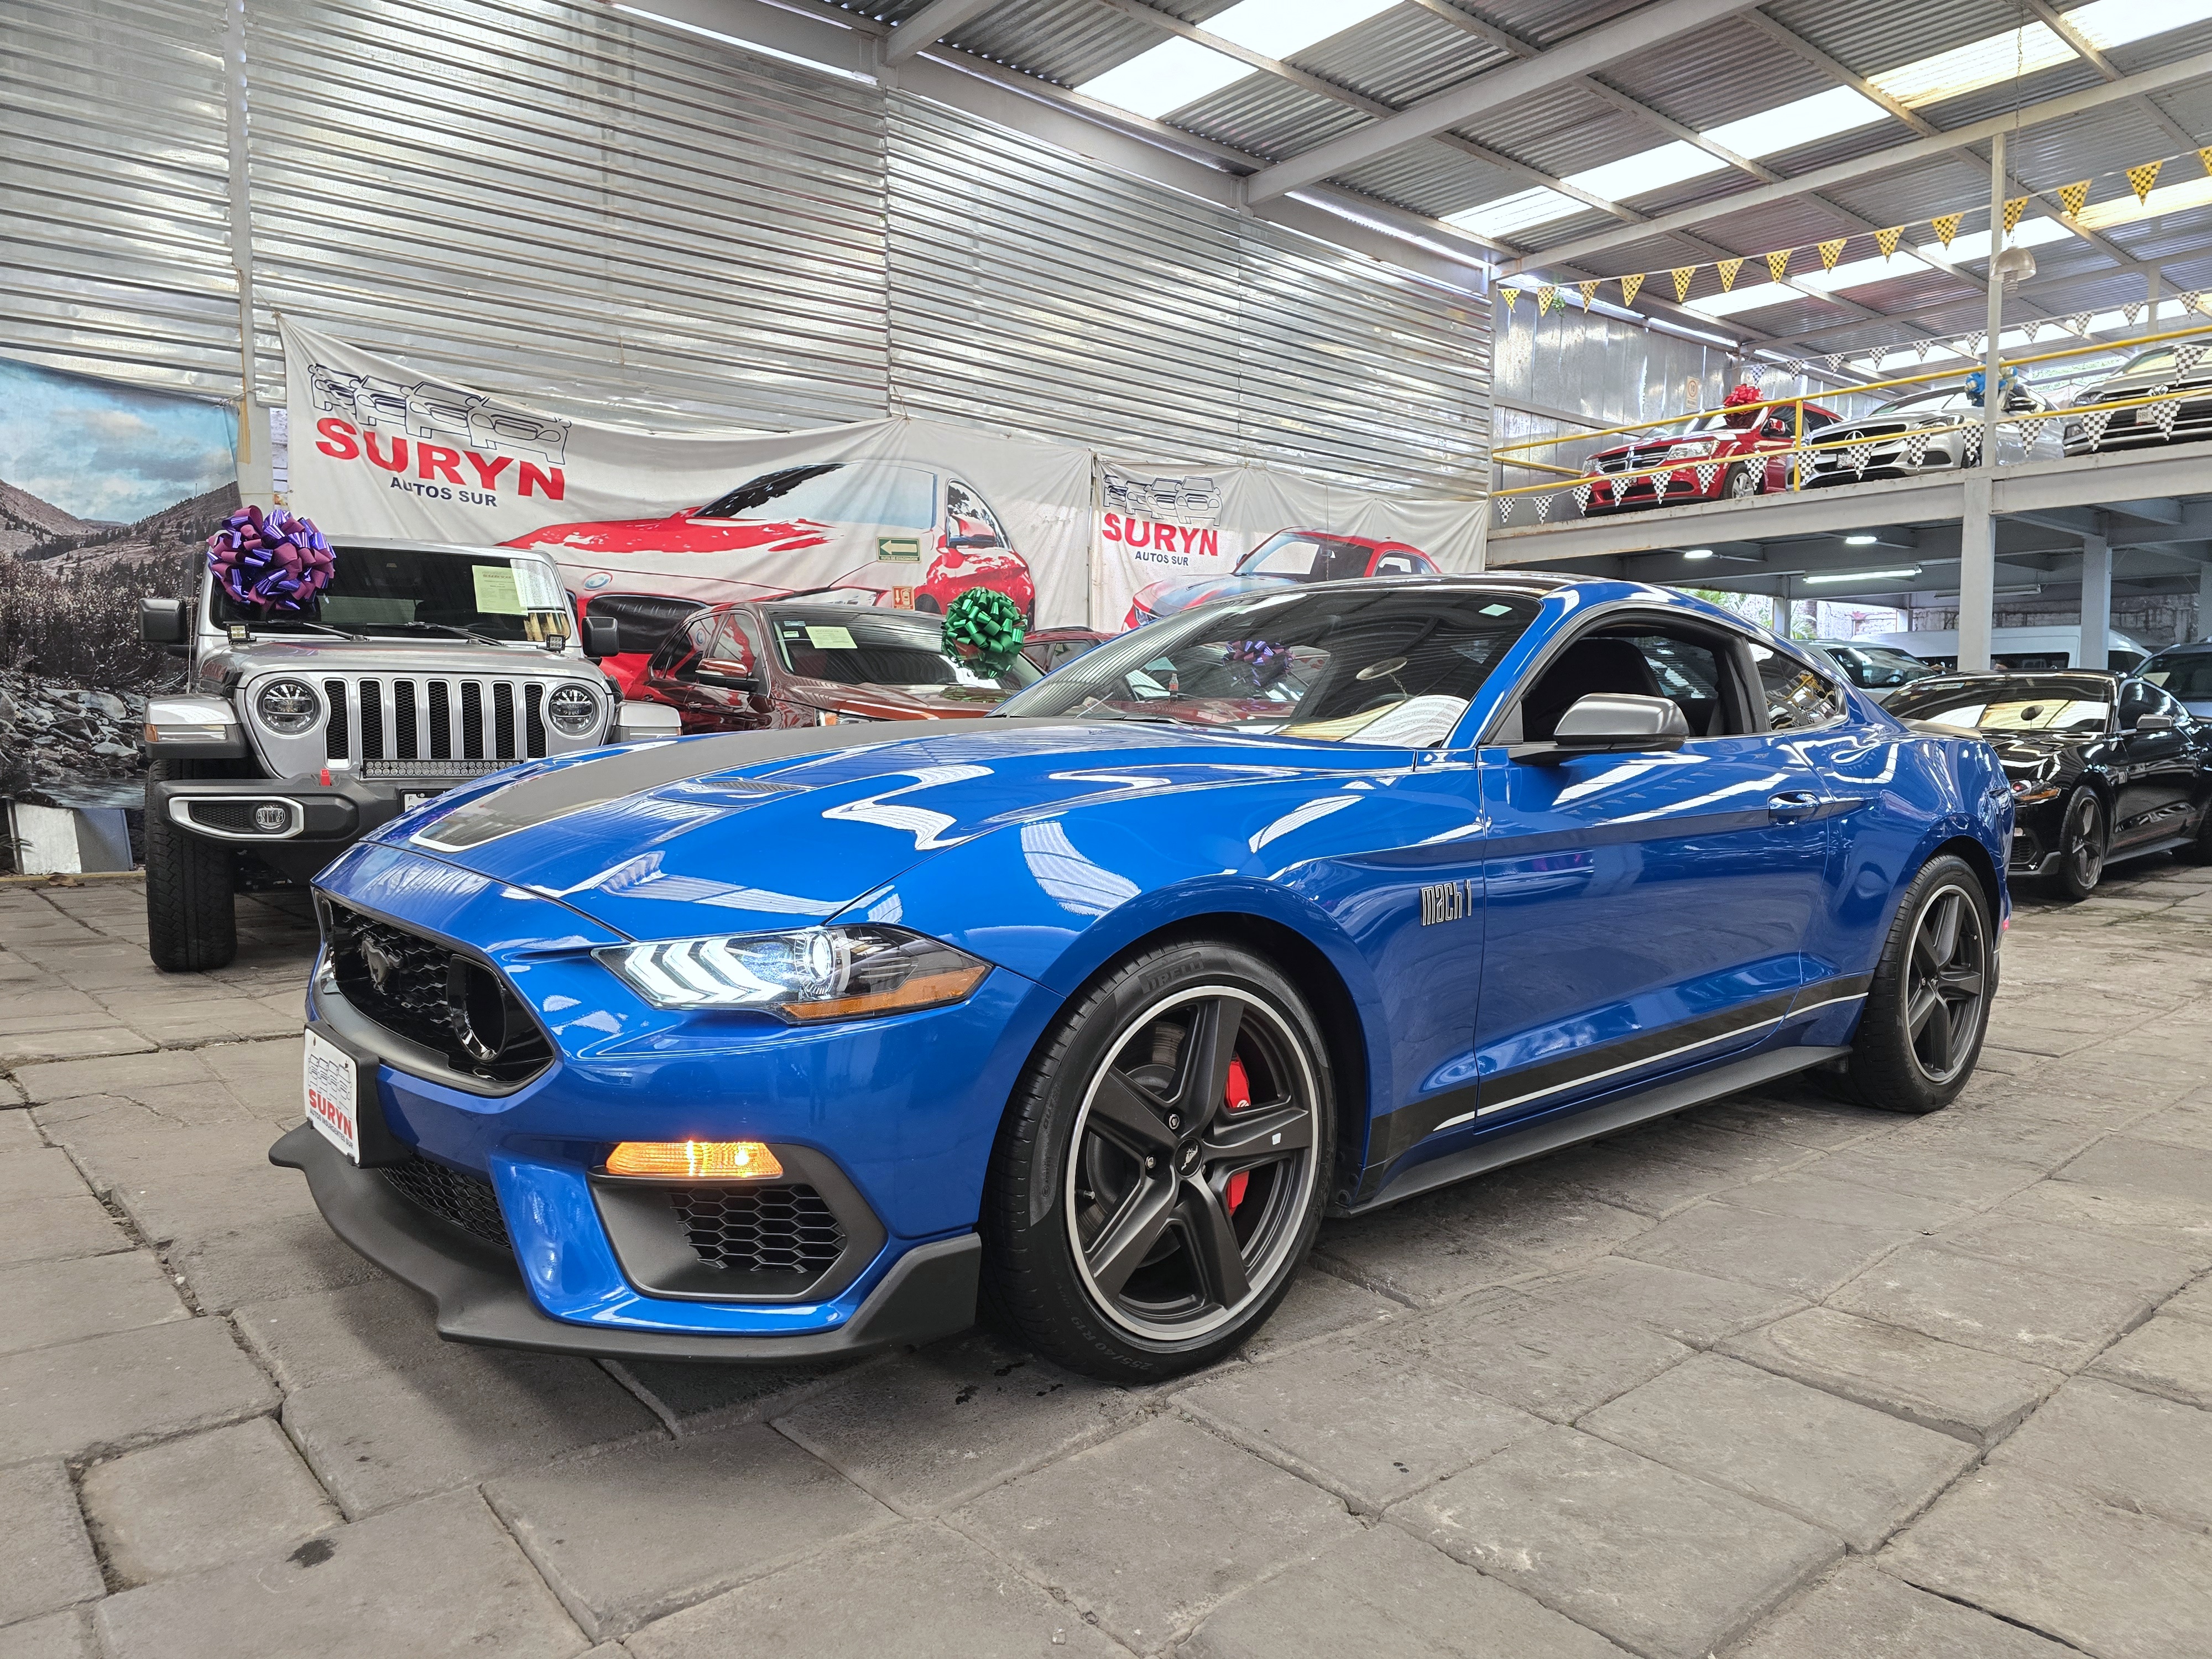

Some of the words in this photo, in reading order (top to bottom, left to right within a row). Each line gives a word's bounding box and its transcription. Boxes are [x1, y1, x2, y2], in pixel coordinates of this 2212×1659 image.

[315, 417, 565, 500] SURYN
[390, 477, 452, 500] AUTOS
[458, 491, 498, 507] SUR
[1102, 512, 1218, 556] SURYN
[1135, 551, 1169, 564] AUTOS
[1171, 556, 1189, 566] SUR
[1464, 878, 1472, 916] 1
[1137, 951, 1206, 994] PIRELLI
[309, 1088, 353, 1140] SURYN
[310, 1107, 322, 1121] AUTOS
[345, 1138, 353, 1150] SUR
[1094, 1342, 1154, 1370] 255/40
